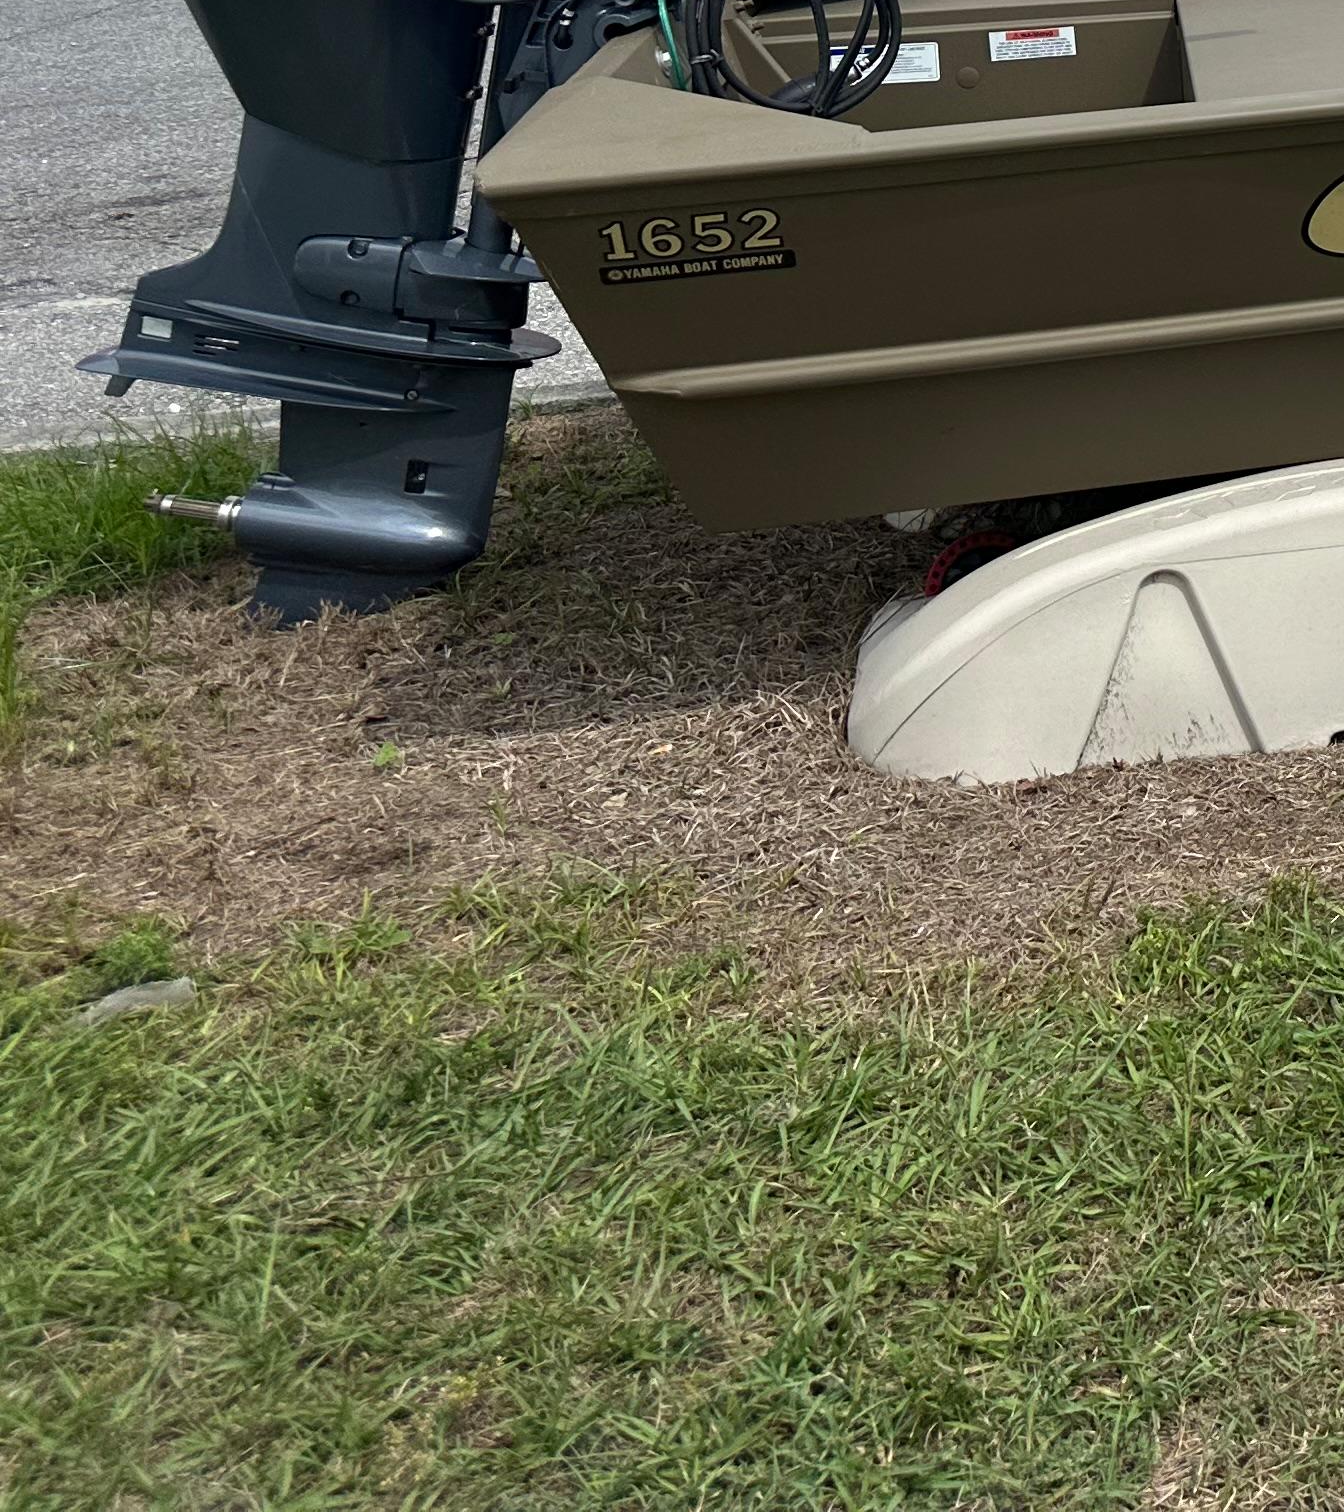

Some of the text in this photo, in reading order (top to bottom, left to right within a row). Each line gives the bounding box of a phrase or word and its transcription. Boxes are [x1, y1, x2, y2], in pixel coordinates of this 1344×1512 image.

[600, 208, 783, 261] 1652
[623, 253, 784, 280] YAMAHA BOAT COMPANY
